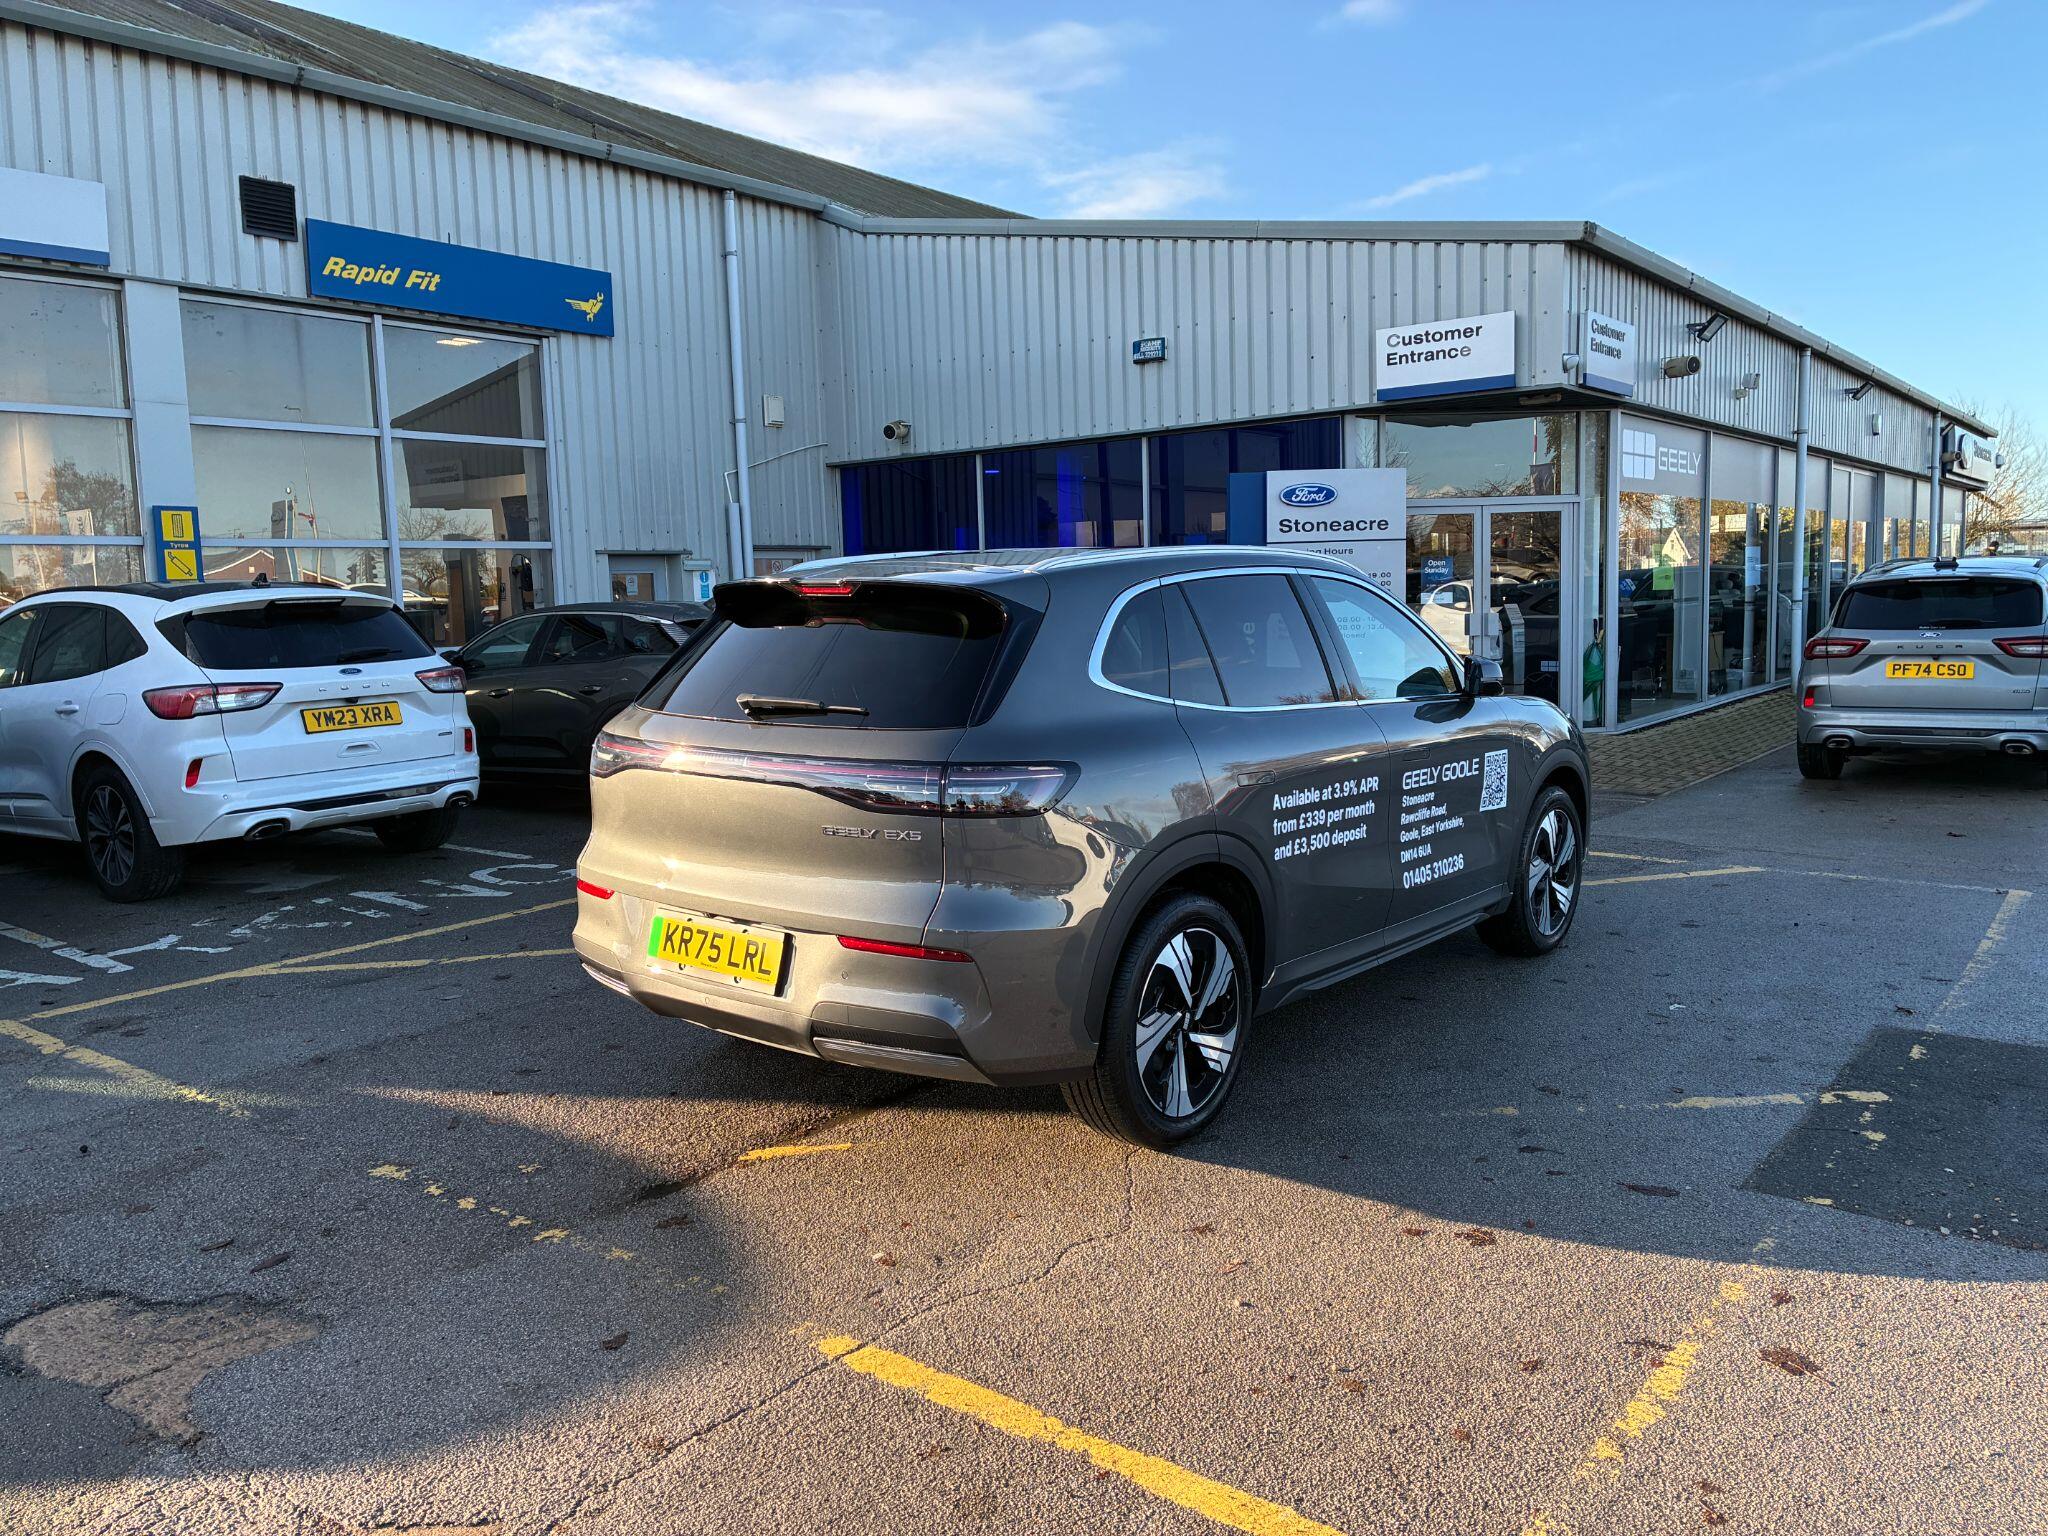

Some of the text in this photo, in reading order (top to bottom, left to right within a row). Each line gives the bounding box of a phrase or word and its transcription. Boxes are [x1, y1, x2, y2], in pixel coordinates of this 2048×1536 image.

[322, 256, 442, 292] Rapid Fit
[1386, 325, 1483, 348] Customer
[1591, 318, 1626, 343] Customer
[1386, 345, 1472, 366] Entrance
[1591, 337, 1622, 360] Entrance
[1658, 446, 1702, 475] GEELY
[1279, 518, 1389, 533] Stoneacre
[1323, 547, 1354, 555] Hours
[1892, 663, 1967, 676] PF74 CSO
[312, 706, 394, 728] YM23 XRA
[1403, 758, 1479, 790] GEELY GOOLE
[1273, 776, 1379, 811] Available at 3.9% APR
[1402, 792, 1435, 807] Stoneacre
[1273, 800, 1375, 836] from £339 per month
[1400, 803, 1448, 825] Rawcliffe Road,
[821, 825, 922, 841] GEELY EX5
[1400, 816, 1465, 843] Goole, East Yorkshire,
[1274, 823, 1367, 860] and £3,500 deposit
[1401, 843, 1432, 863] DN14 6UA
[1403, 853, 1464, 889] 01405 310236
[663, 922, 772, 976] KR75 LRL
